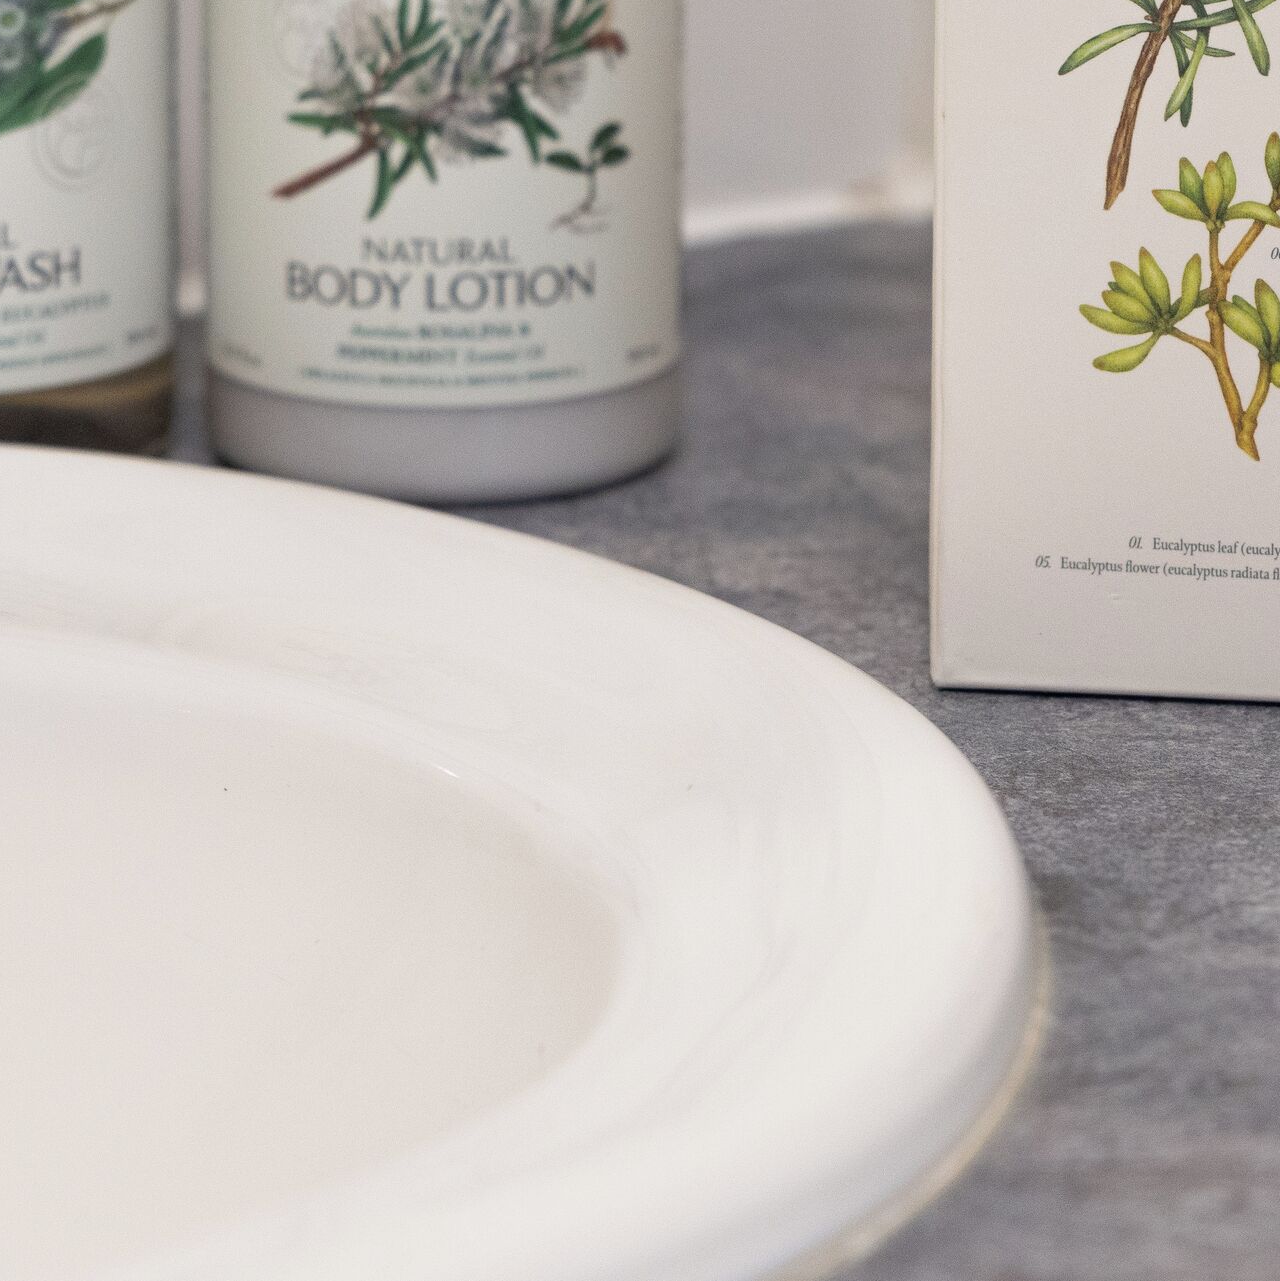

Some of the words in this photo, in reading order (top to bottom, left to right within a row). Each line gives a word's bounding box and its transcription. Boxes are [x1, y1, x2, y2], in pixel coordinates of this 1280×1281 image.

[360, 236, 516, 267] NATURAL
[286, 260, 412, 312] BODY
[425, 260, 597, 313] LOTION
[1128, 535, 1143, 550] 01.
[1152, 536, 1216, 556] Eucalyptus
[1217, 540, 1239, 555] leaf
[1034, 555, 1051, 569] 05.
[1060, 556, 1123, 576] Eucalyptus
[1125, 559, 1161, 575] flower
[1162, 562, 1229, 581] (eucalyptus
[1230, 565, 1270, 580] radiata
